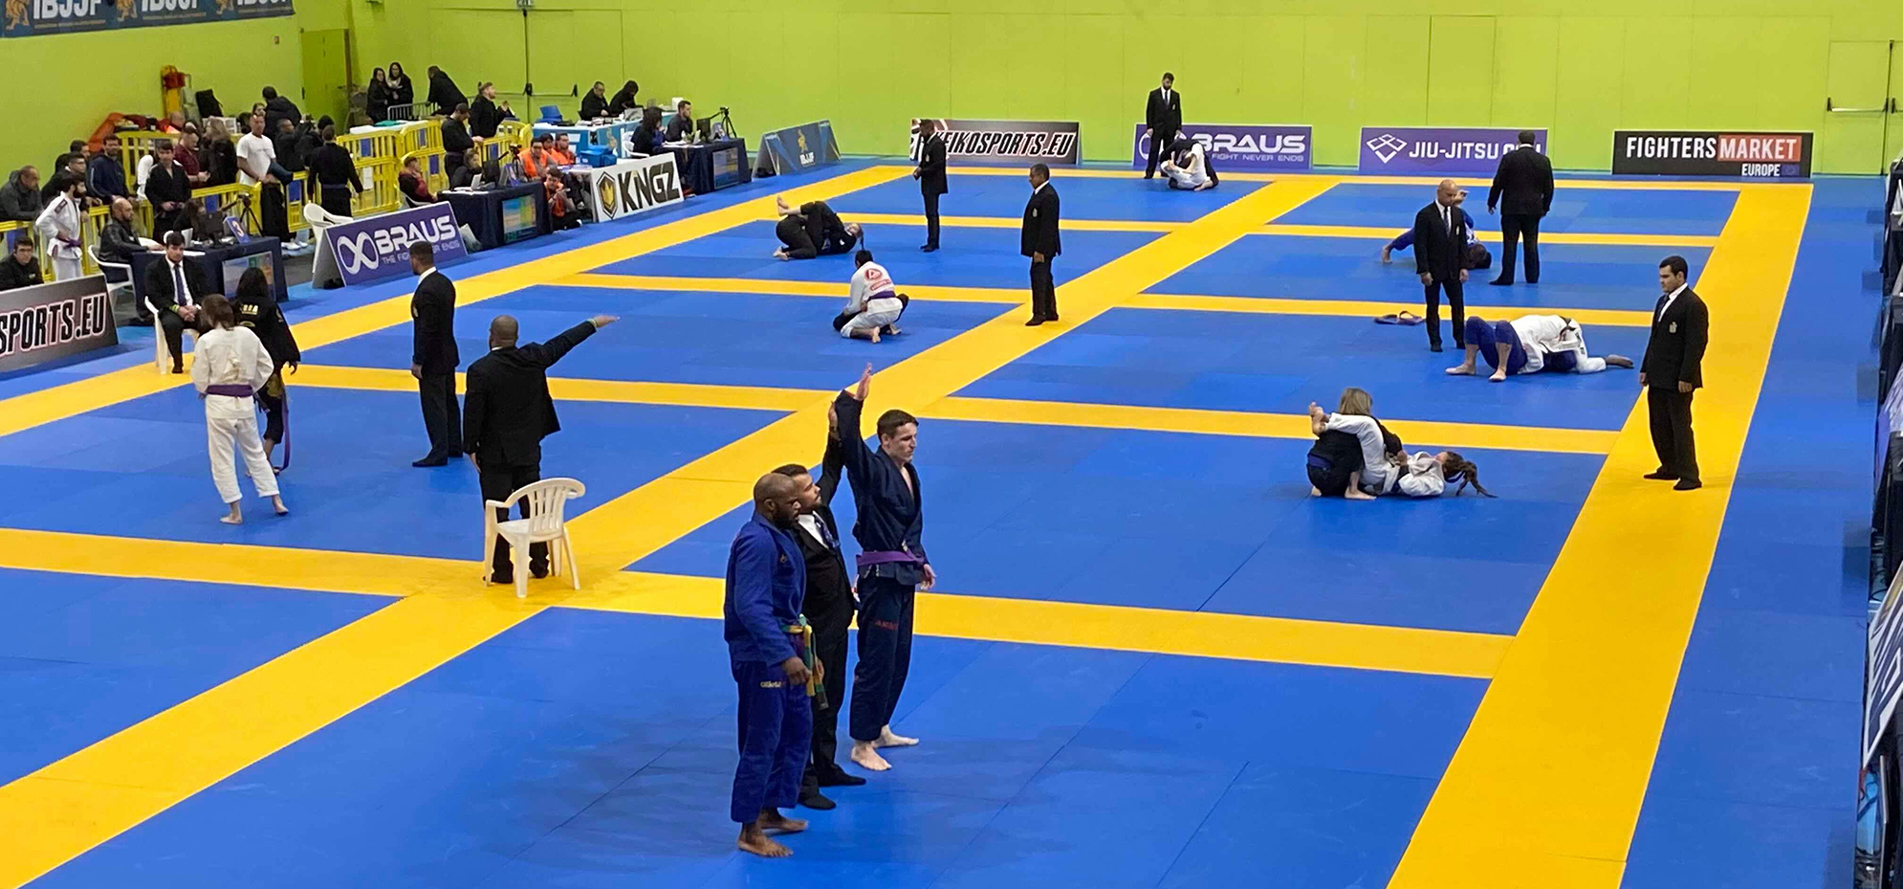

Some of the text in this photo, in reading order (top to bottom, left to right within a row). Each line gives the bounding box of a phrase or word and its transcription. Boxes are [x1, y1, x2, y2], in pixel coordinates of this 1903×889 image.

[1191, 134, 1306, 154] BRAUS
[1408, 141, 1499, 159] JIU-JITSU
[1626, 136, 1798, 160] FIGHTERS MARKET
[1212, 153, 1239, 161] FIGHT
[1278, 154, 1304, 162] ENDS
[1741, 162, 1781, 177] EUROPE
[618, 167, 680, 212] KNGZ
[375, 216, 456, 254] BRAUS
